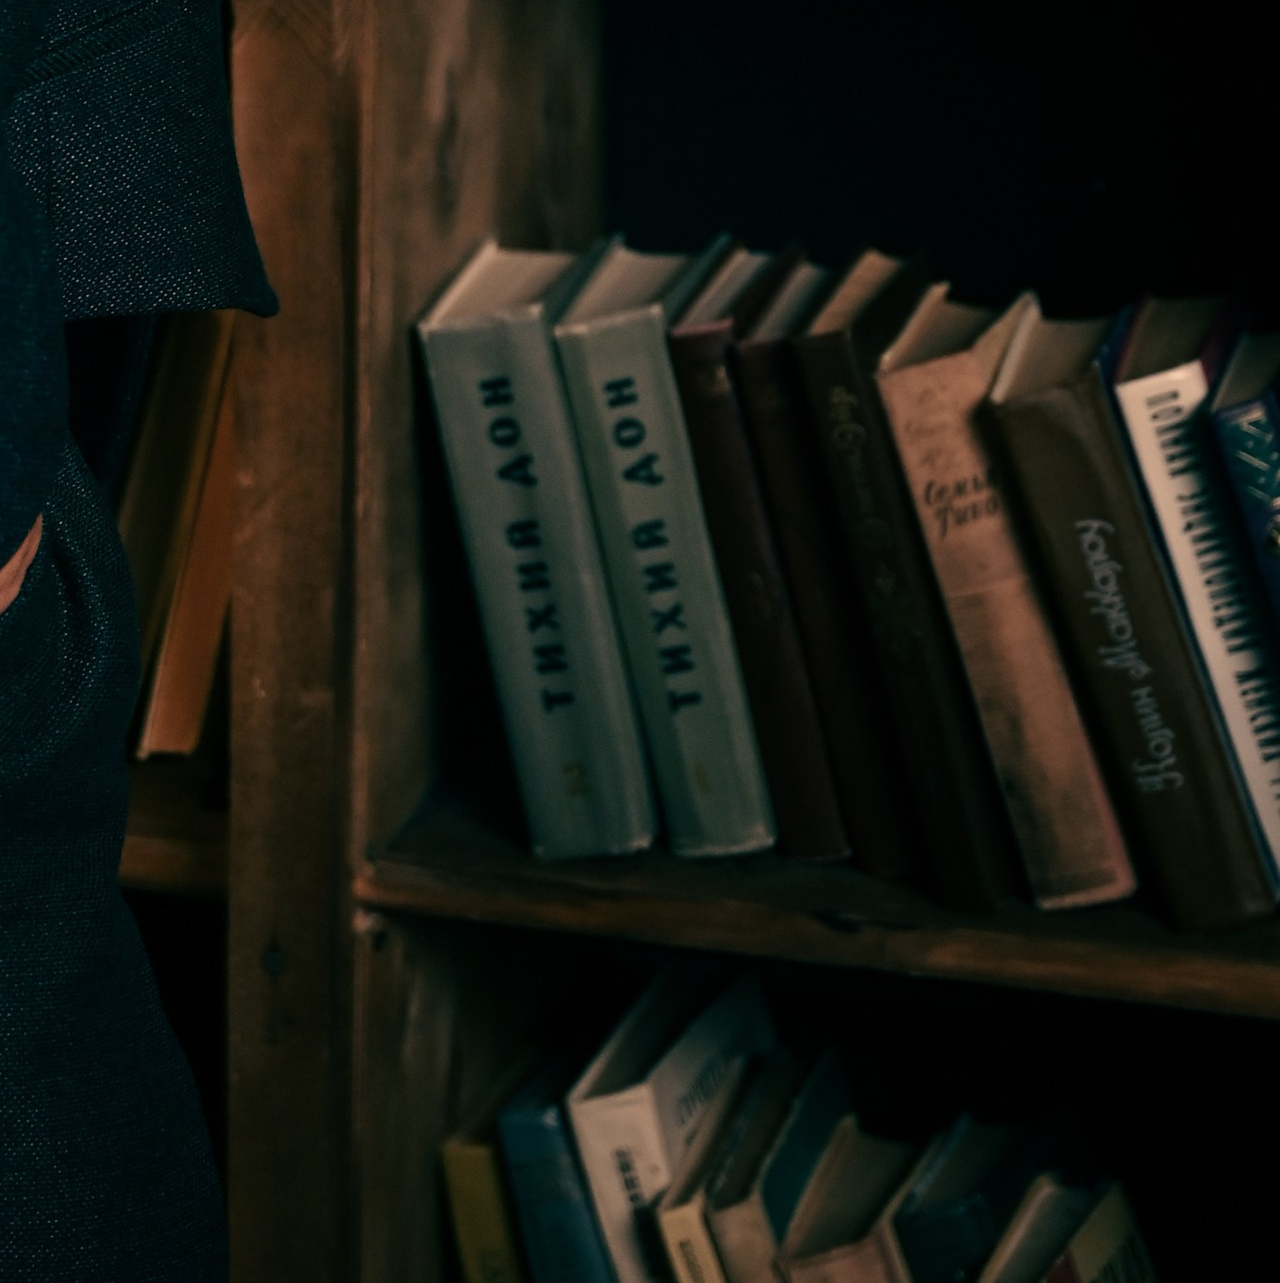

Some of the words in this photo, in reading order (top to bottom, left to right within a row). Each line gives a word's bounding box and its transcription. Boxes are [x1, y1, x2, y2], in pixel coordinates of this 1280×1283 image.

[480, 377, 538, 487] ДОН
[604, 377, 664, 487] ДОН
[507, 518, 575, 713] ТИХИЙ
[632, 518, 702, 714] ТИХИЙ
[1131, 684, 1185, 795] Колин
